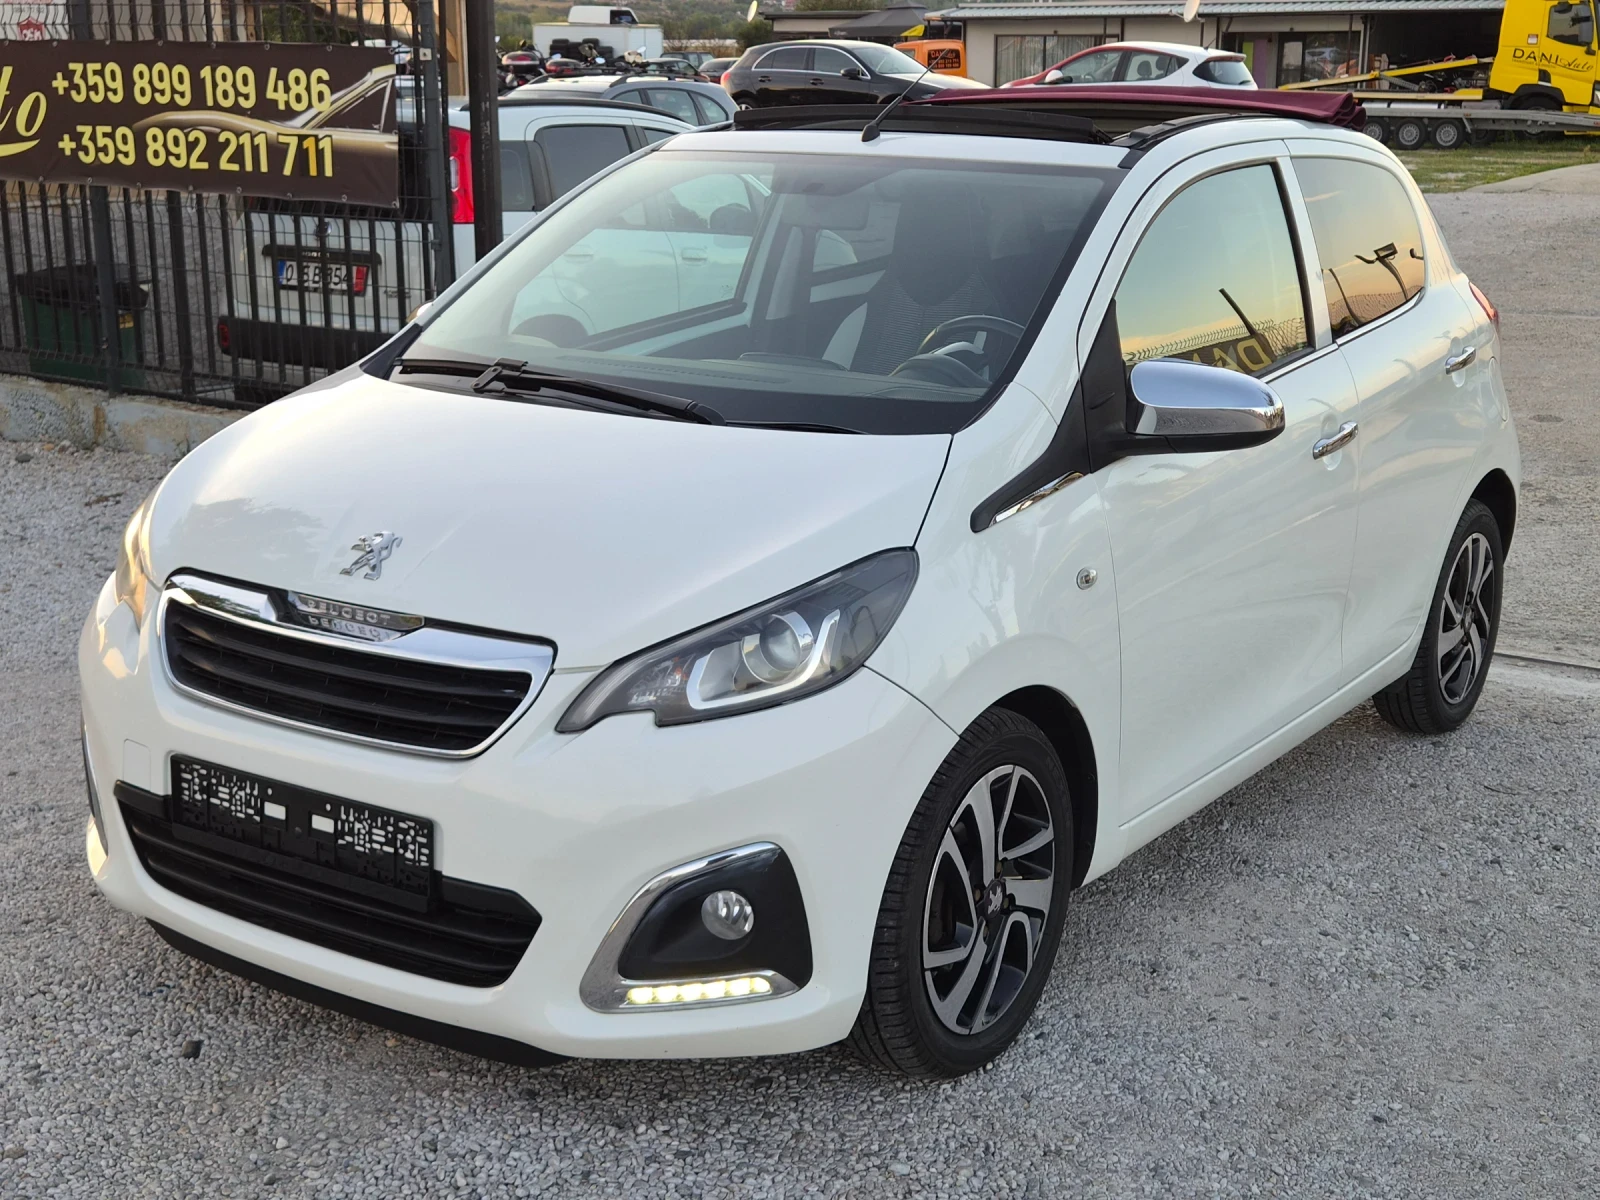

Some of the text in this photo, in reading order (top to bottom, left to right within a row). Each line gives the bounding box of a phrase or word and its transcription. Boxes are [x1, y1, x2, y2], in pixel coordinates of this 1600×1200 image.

[1512, 47, 1559, 65] DANI
[51, 61, 331, 112] +359 899 189 486
[58, 125, 333, 177] +359 892 211 711
[306, 599, 391, 626] PEUGEOT
